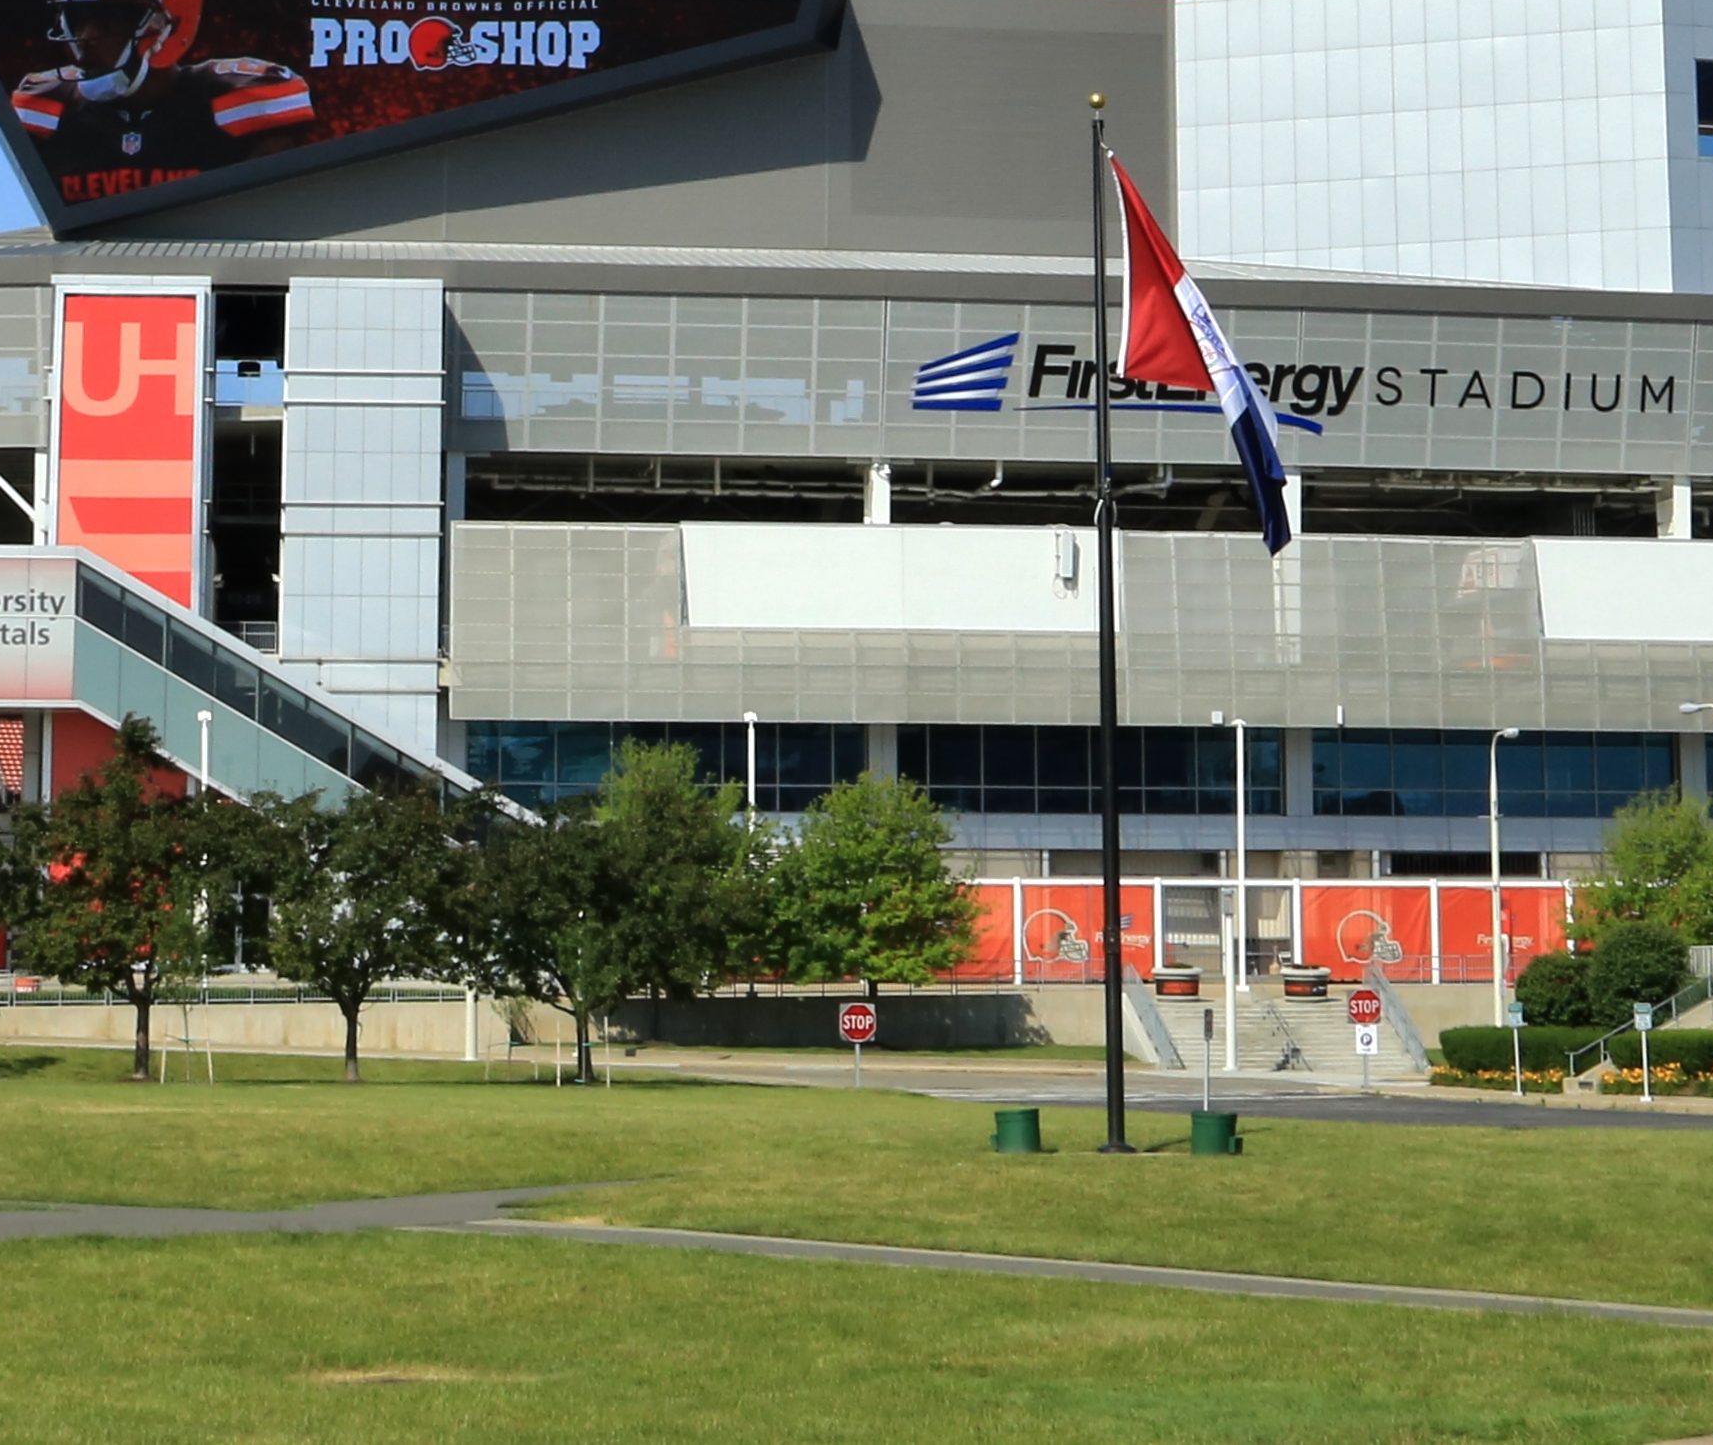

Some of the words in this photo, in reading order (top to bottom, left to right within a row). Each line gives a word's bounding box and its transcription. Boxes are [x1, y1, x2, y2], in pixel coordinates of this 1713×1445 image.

[426, 1, 503, 12] BROWNS
[310, 17, 410, 68] PRO
[469, 20, 601, 69] SHOP
[62, 322, 196, 417] UH
[1376, 366, 1675, 414] STADIUM
[1350, 999, 1380, 1014] STOP
[843, 1015, 874, 1030] STOP
